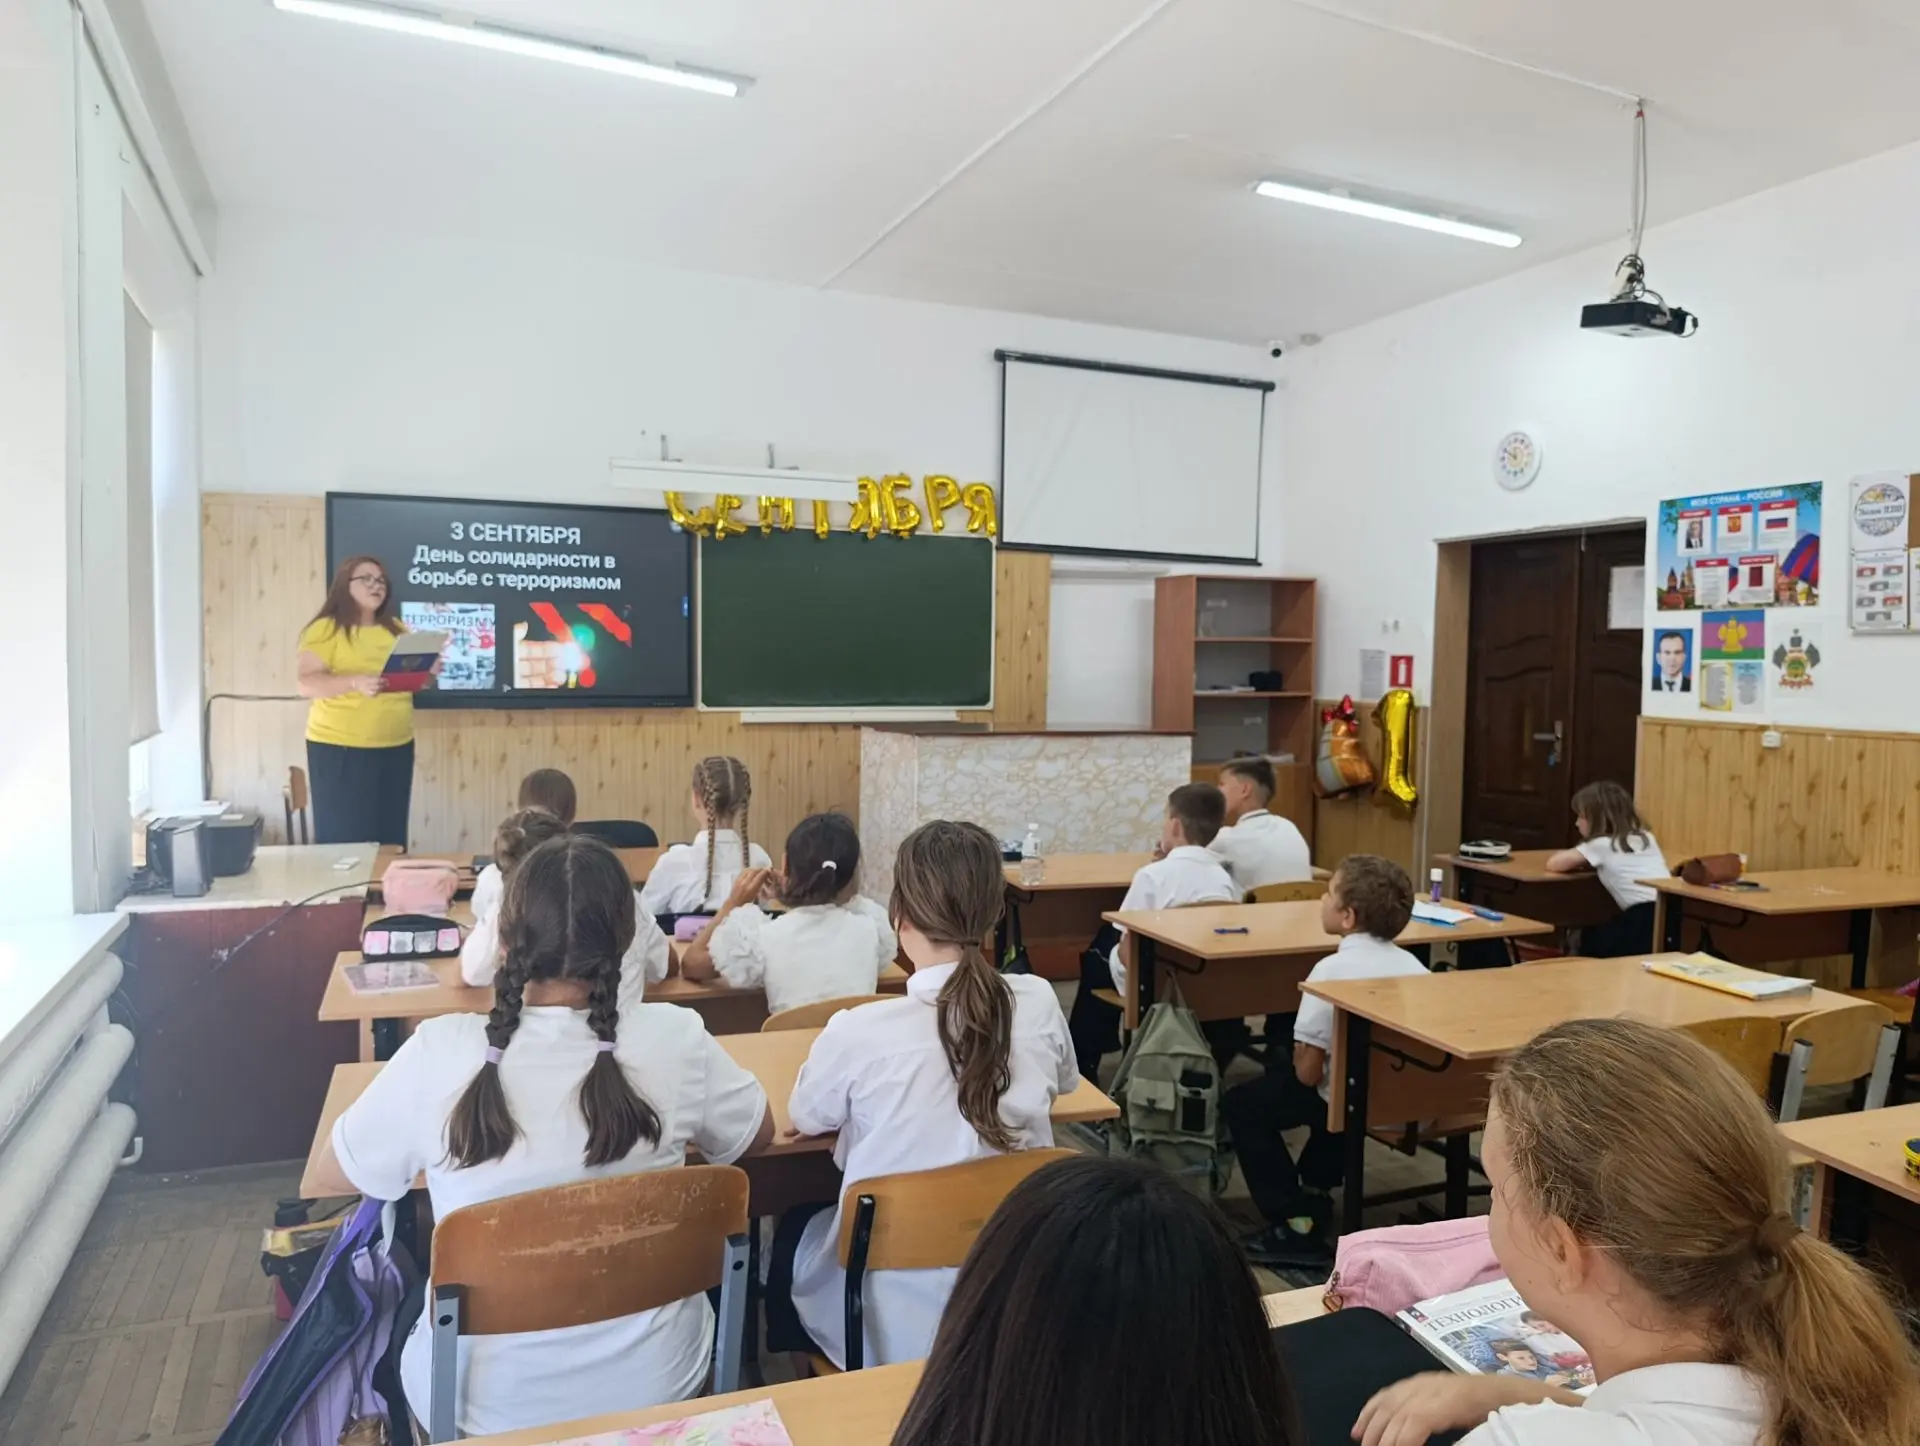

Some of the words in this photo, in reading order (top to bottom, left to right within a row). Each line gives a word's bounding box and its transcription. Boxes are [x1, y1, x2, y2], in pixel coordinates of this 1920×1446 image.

[469, 522, 581, 545] СЕНТЯБРЯ
[412, 545, 465, 565] День
[467, 549, 599, 569] солидарности
[604, 556, 616, 569] в
[407, 567, 478, 588] борьбе
[481, 574, 493, 587] с
[496, 573, 621, 592] терроризмом
[1425, 1295, 1521, 1331] ТЕХНОЛОГИ
